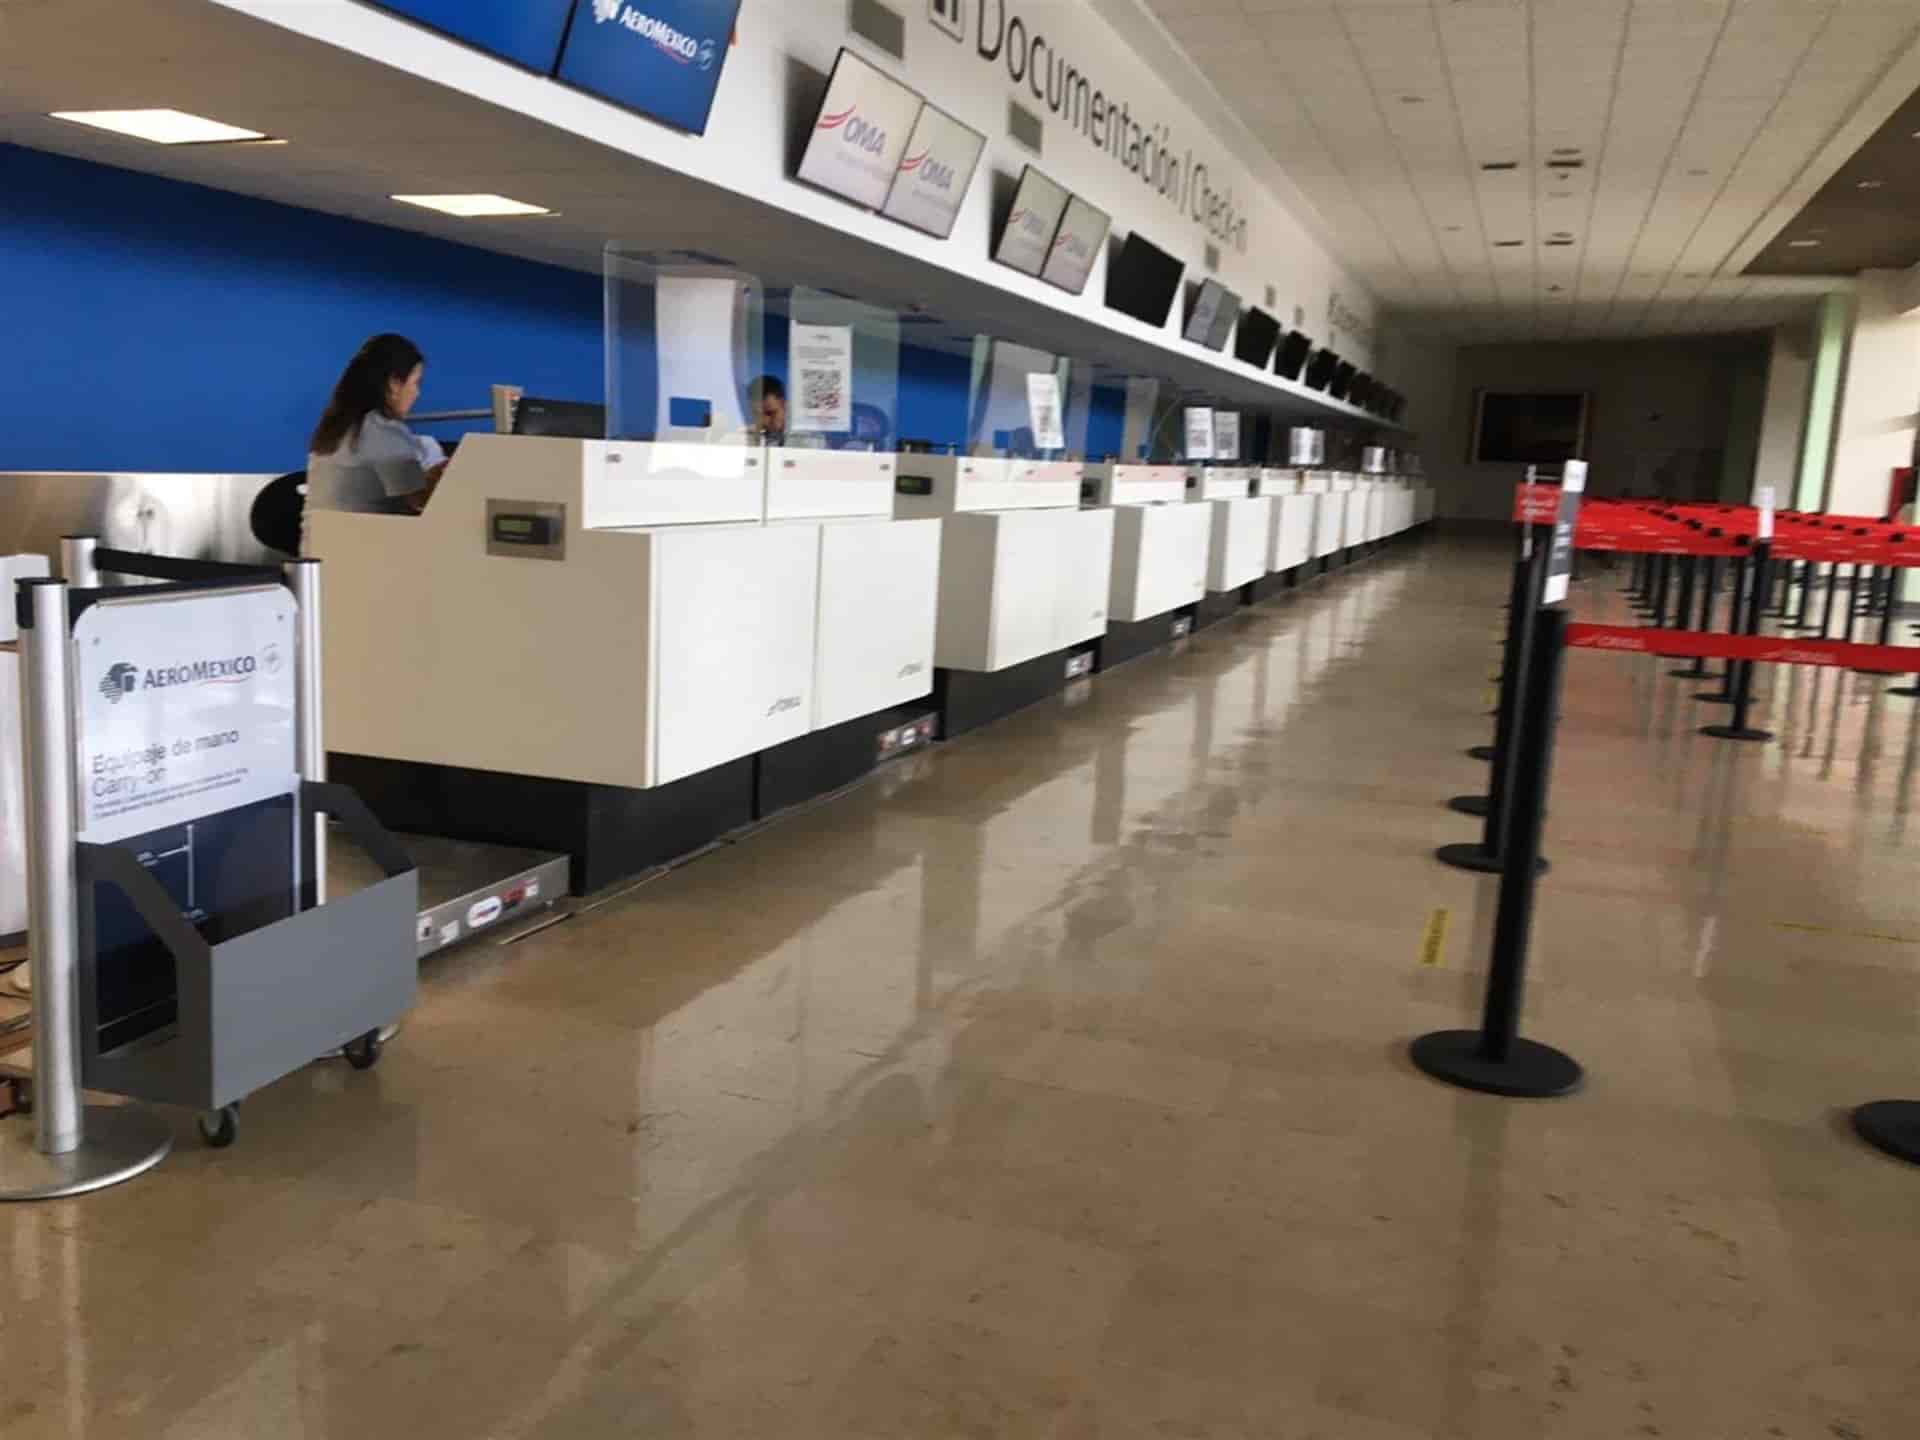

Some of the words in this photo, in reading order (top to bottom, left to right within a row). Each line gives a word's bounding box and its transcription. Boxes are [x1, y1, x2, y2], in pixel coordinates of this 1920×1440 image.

[977, 0, 1180, 206] Documentación
[843, 115, 886, 157] OMA
[142, 655, 257, 690] AEROMEXICO
[171, 738, 192, 757] de
[195, 730, 240, 750] mano
